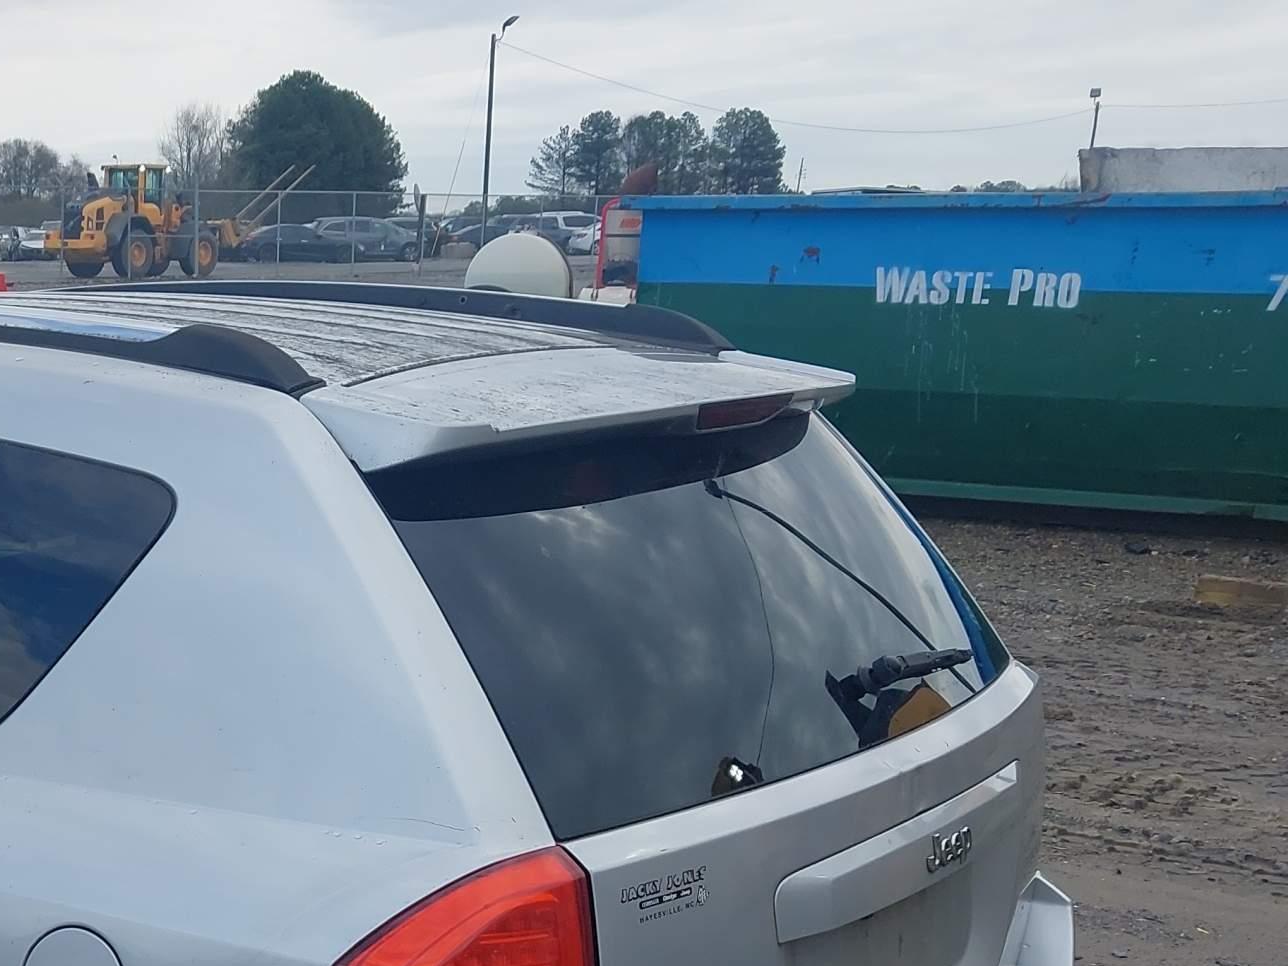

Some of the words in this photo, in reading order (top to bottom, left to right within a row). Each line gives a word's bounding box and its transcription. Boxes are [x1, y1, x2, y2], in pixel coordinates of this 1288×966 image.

[876, 266, 994, 305] WASTE
[1008, 269, 1082, 309] PRO
[926, 826, 972, 873] Jeep
[620, 878, 663, 904] JACKY
[666, 865, 706, 890] JONES
